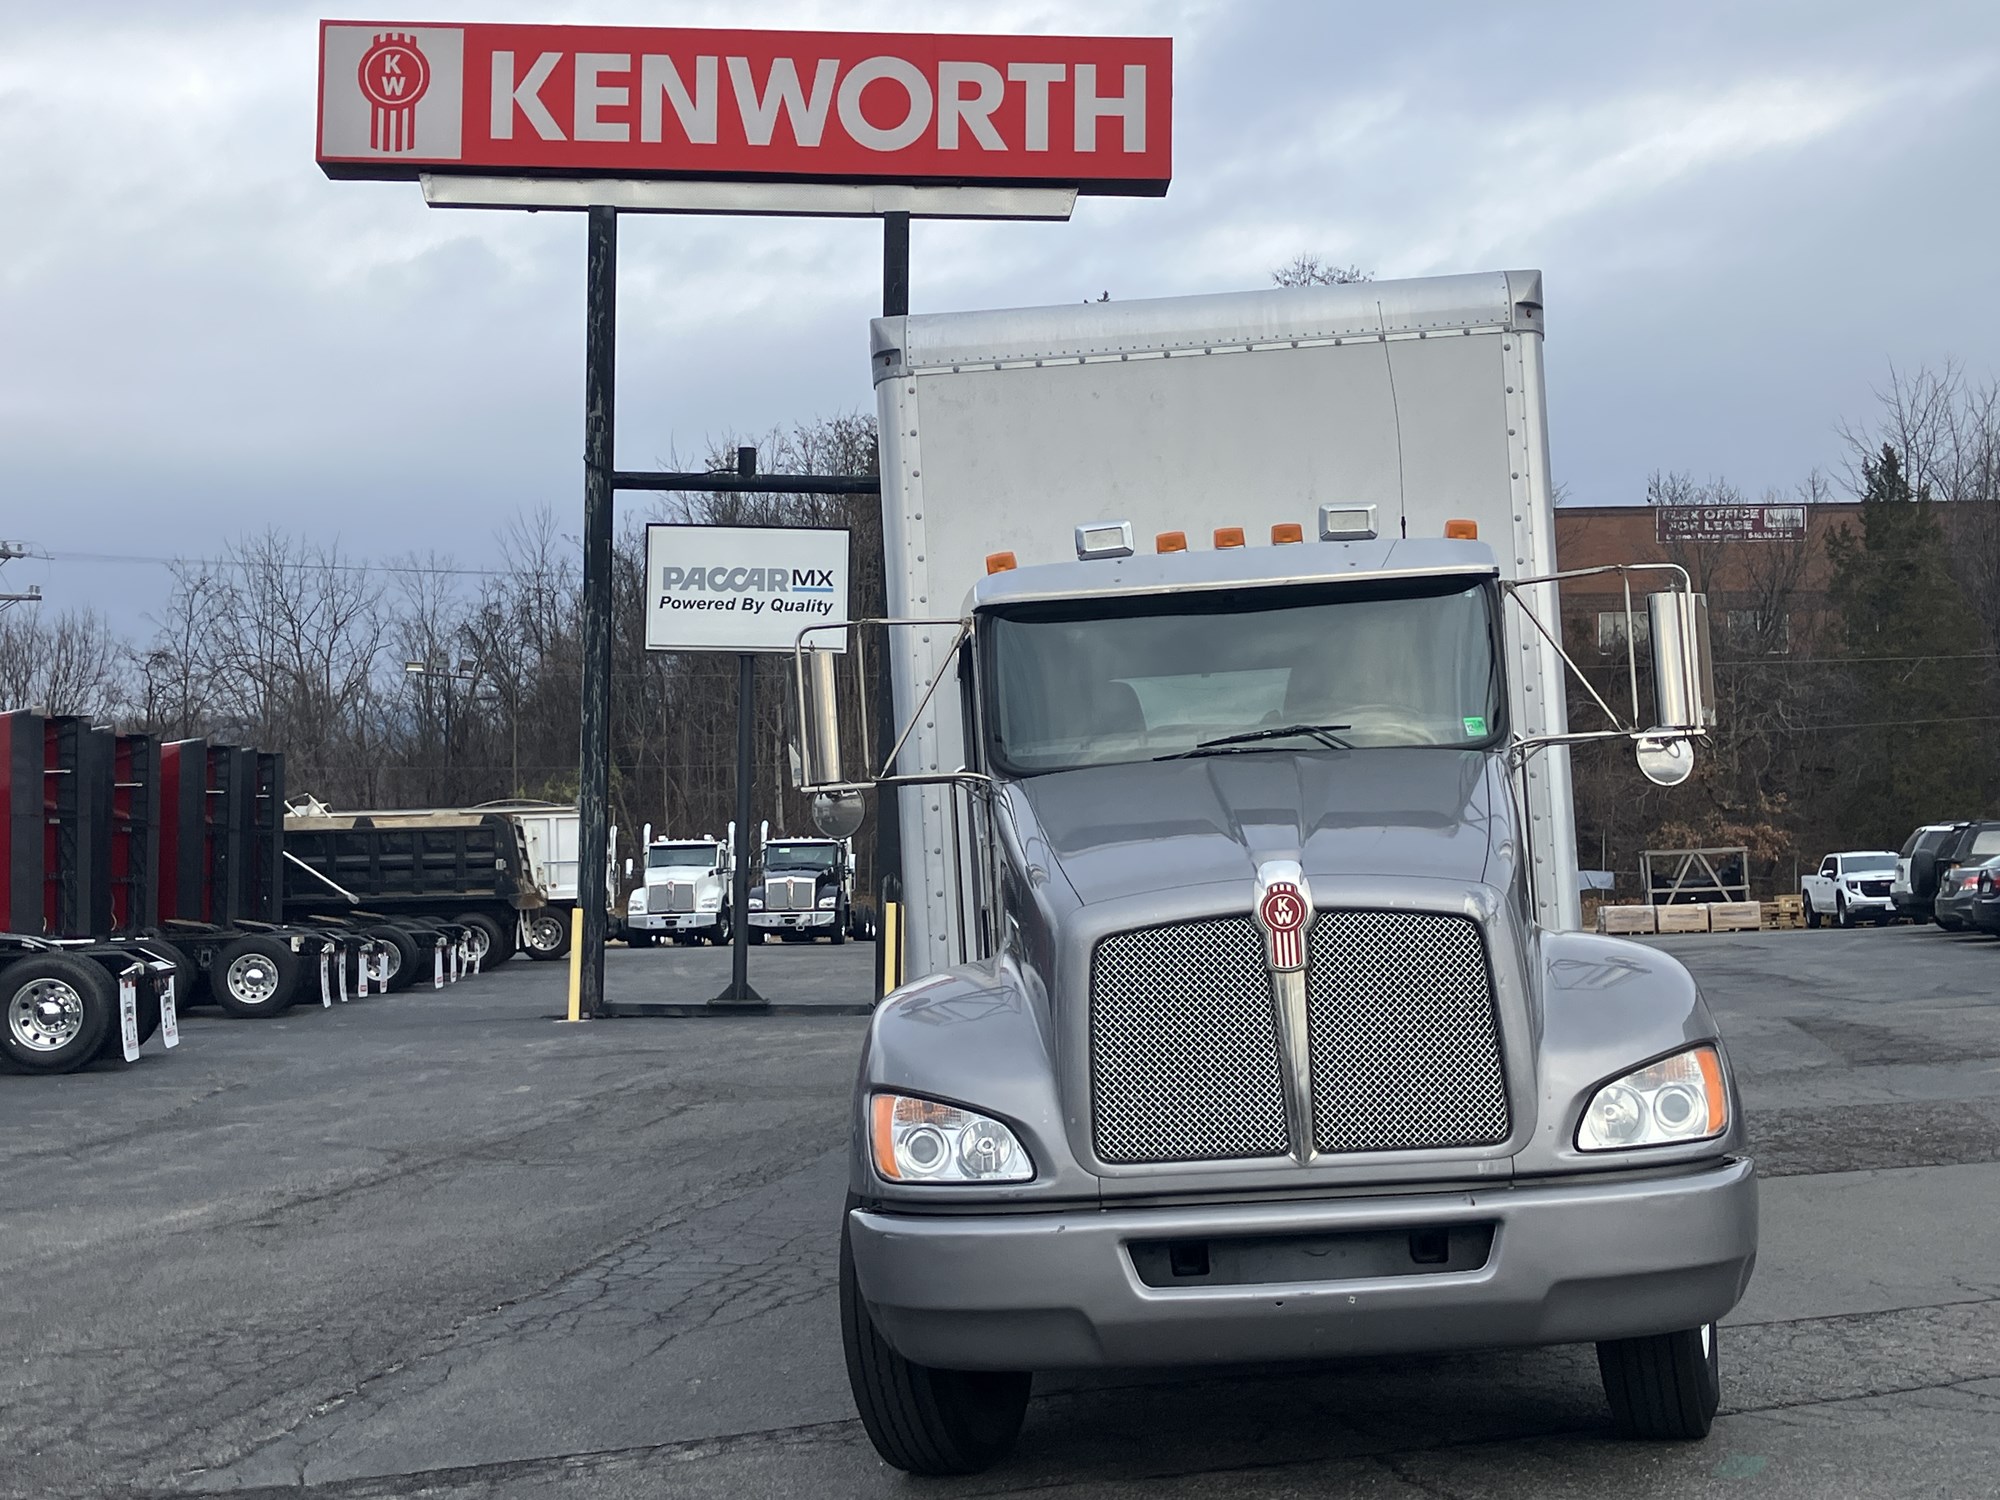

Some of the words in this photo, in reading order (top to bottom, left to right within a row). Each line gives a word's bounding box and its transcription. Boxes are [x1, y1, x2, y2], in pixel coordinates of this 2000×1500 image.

[489, 50, 1147, 153] KENWORTH
[1703, 508, 1760, 520] OFFICE
[1704, 519, 1753, 531] LEASE
[663, 567, 789, 592] PACCAR
[659, 596, 737, 610] Powered
[741, 597, 765, 615] By
[770, 598, 834, 616] Quality
